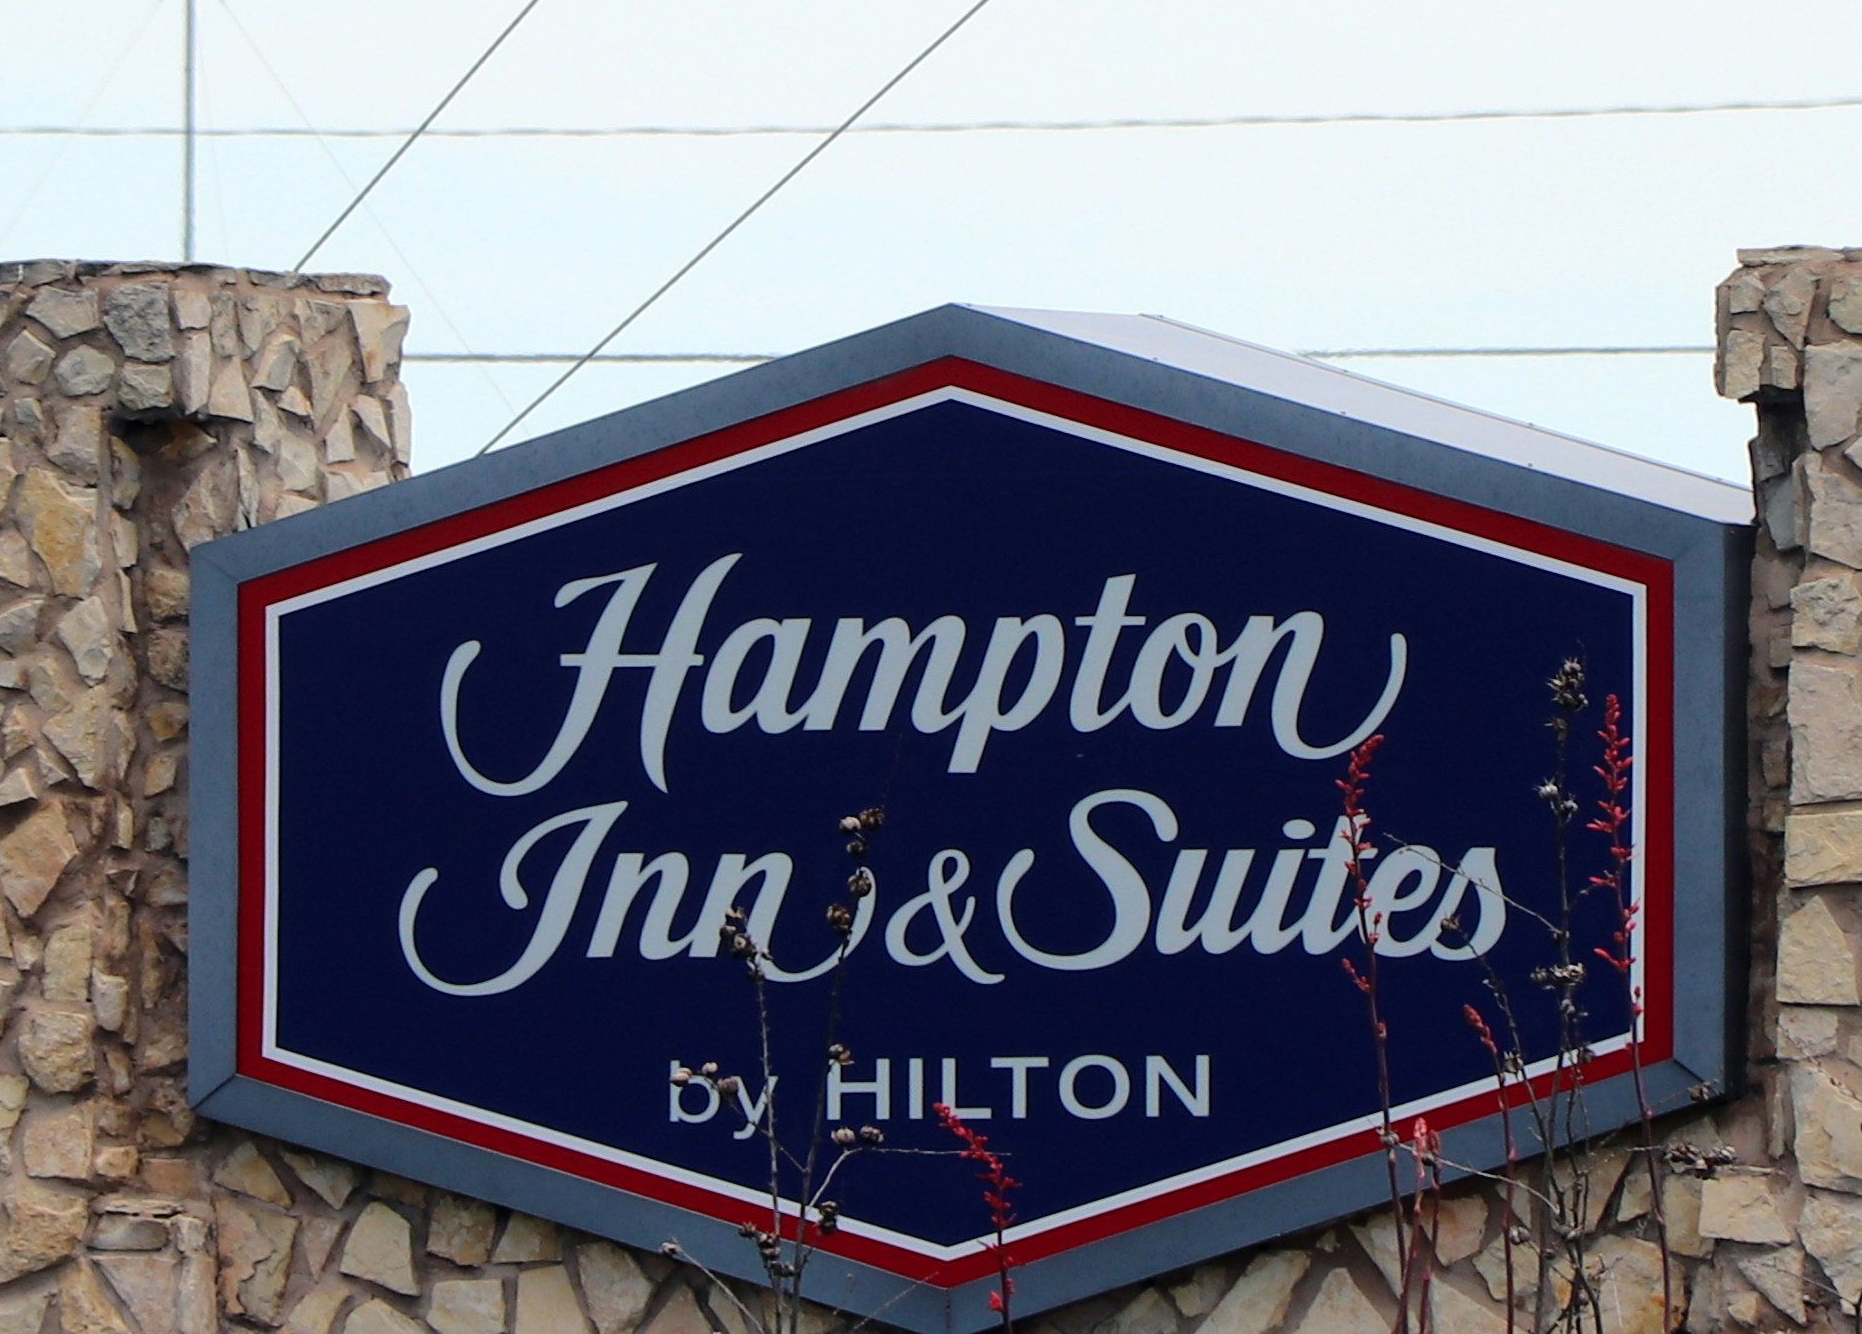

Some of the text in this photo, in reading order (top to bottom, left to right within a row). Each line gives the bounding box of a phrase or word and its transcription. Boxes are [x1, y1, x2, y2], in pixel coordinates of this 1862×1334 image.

[441, 552, 1407, 797] Hampton
[398, 789, 1507, 997] Inn & Suites
[668, 1054, 1210, 1140] by HILTON
